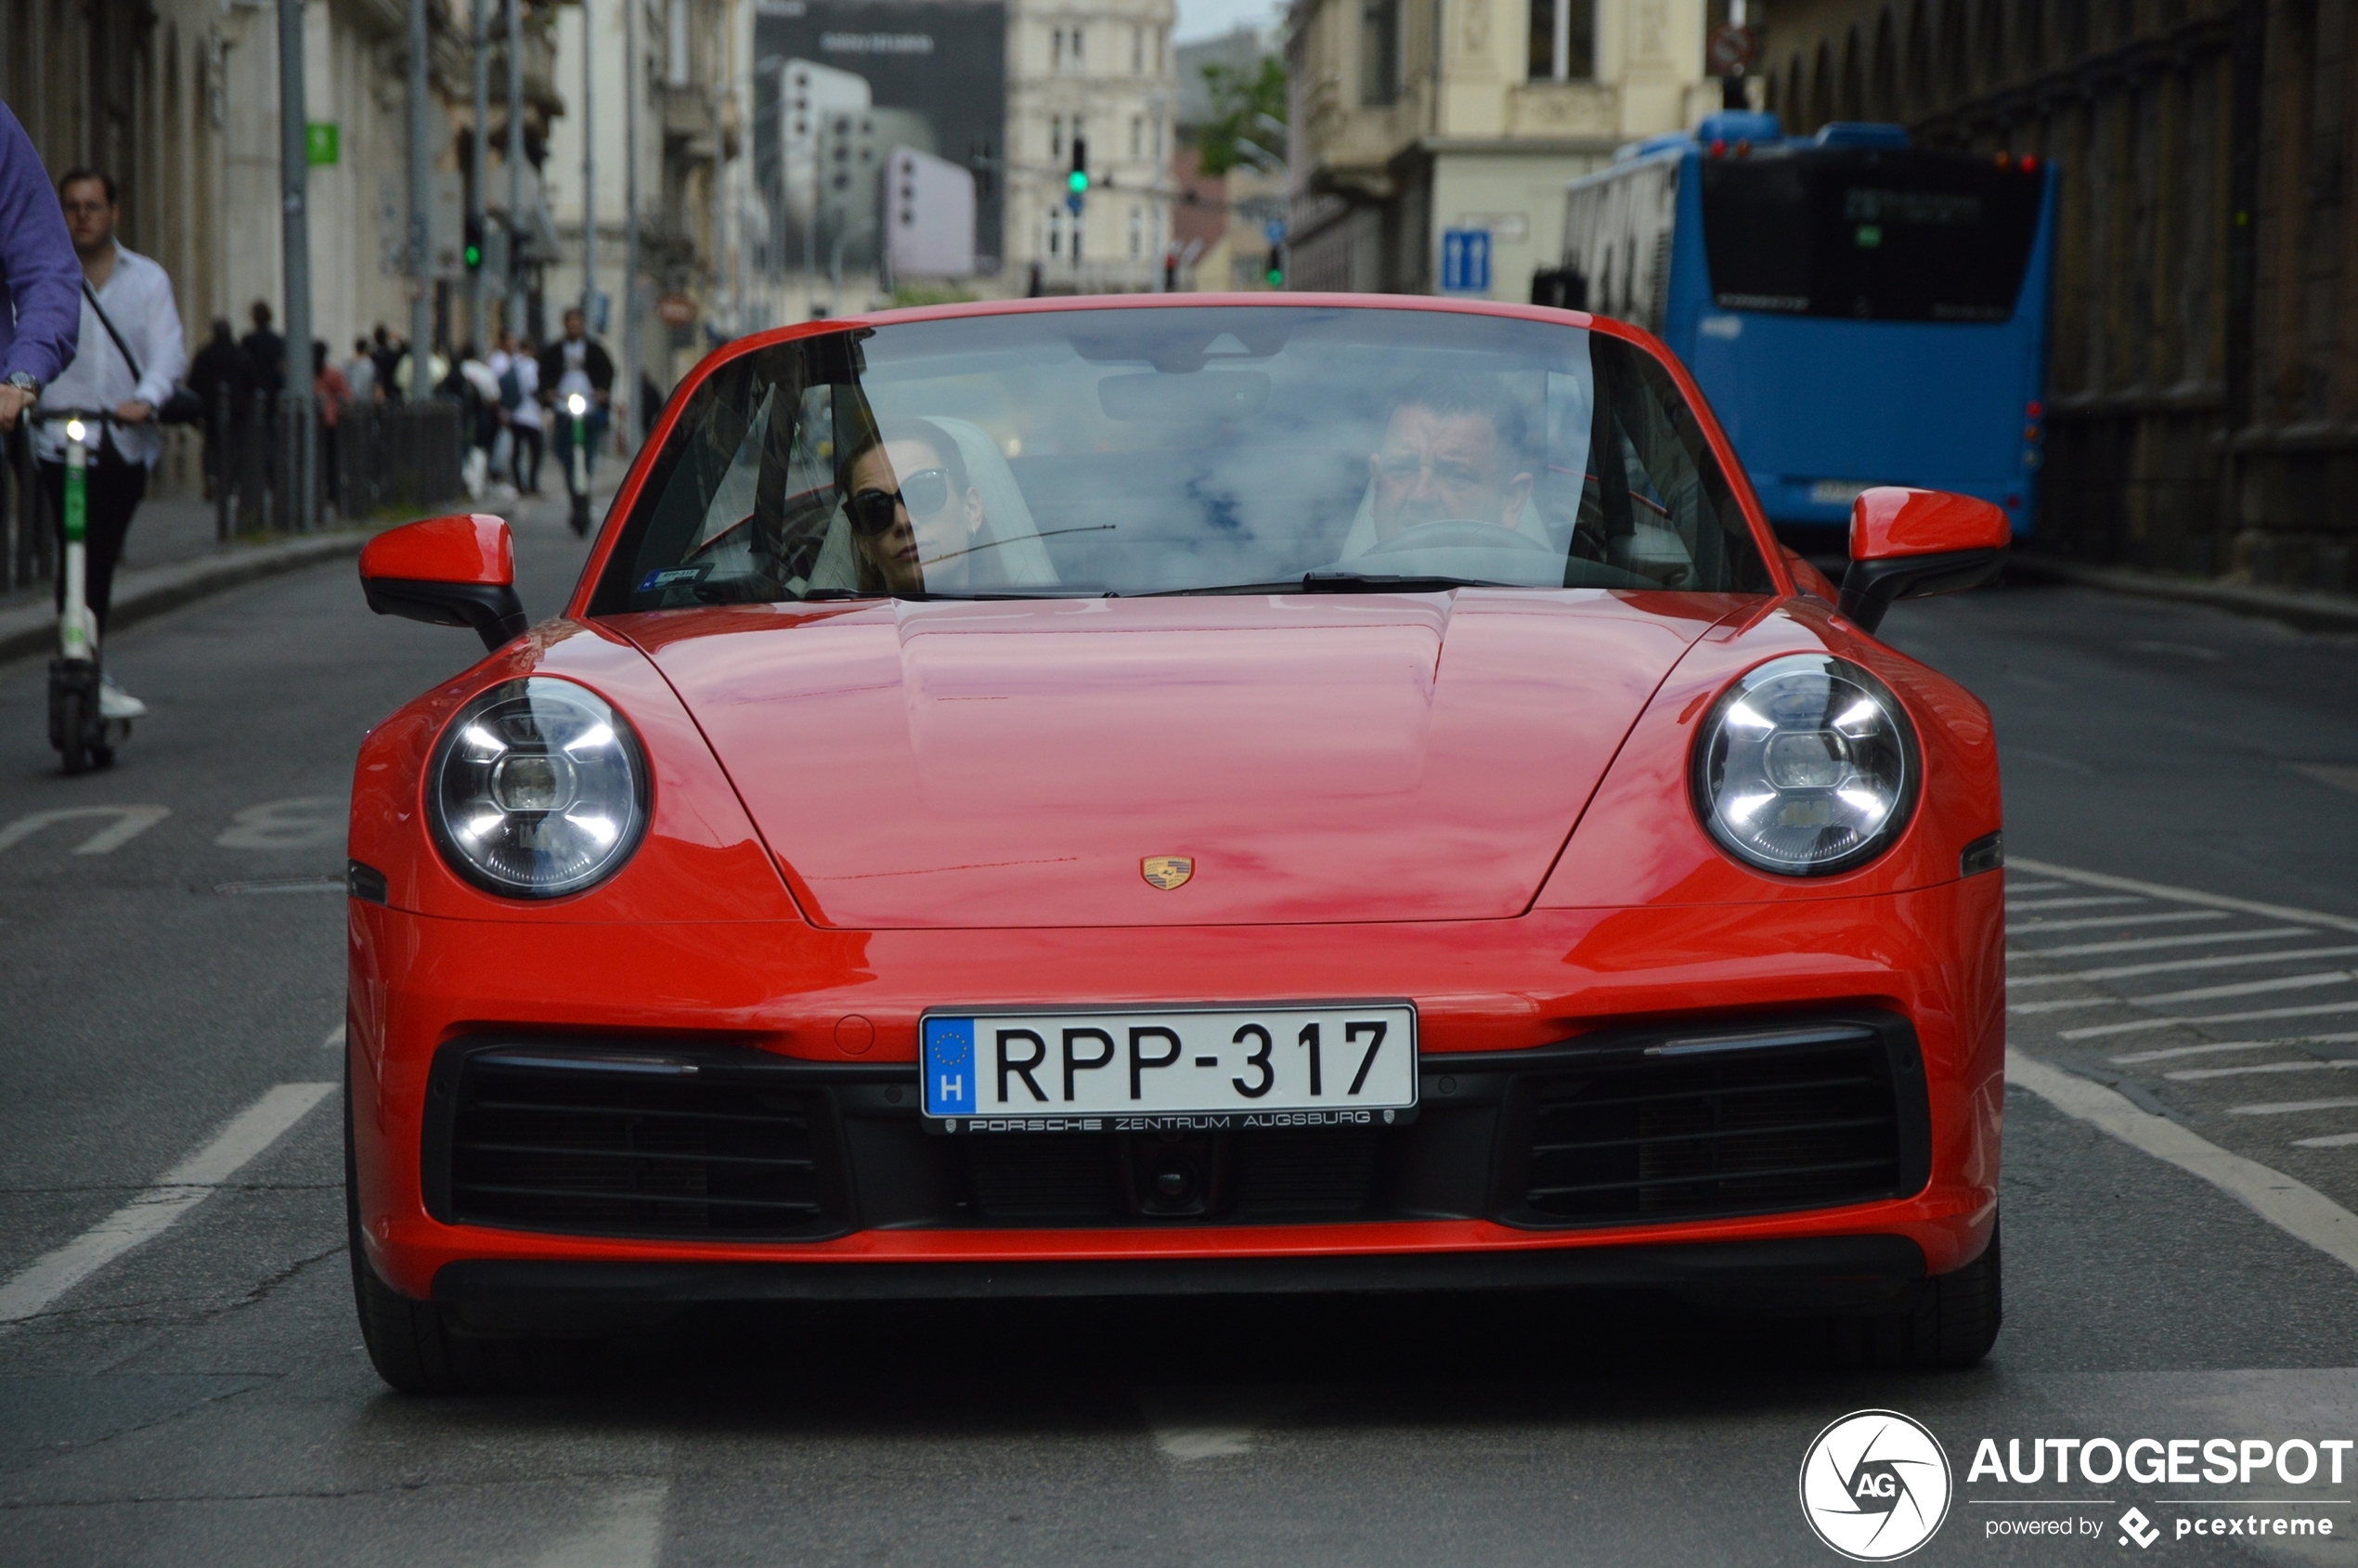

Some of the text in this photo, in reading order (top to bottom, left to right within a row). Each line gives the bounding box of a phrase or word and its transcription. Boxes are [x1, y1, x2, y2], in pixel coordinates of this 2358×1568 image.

[663, 570, 694, 578] RPP-317
[941, 1020, 1388, 1103] H RPP-317
[968, 1110, 1371, 1132] PORSCHE ZENTRUM AUGSBURG
